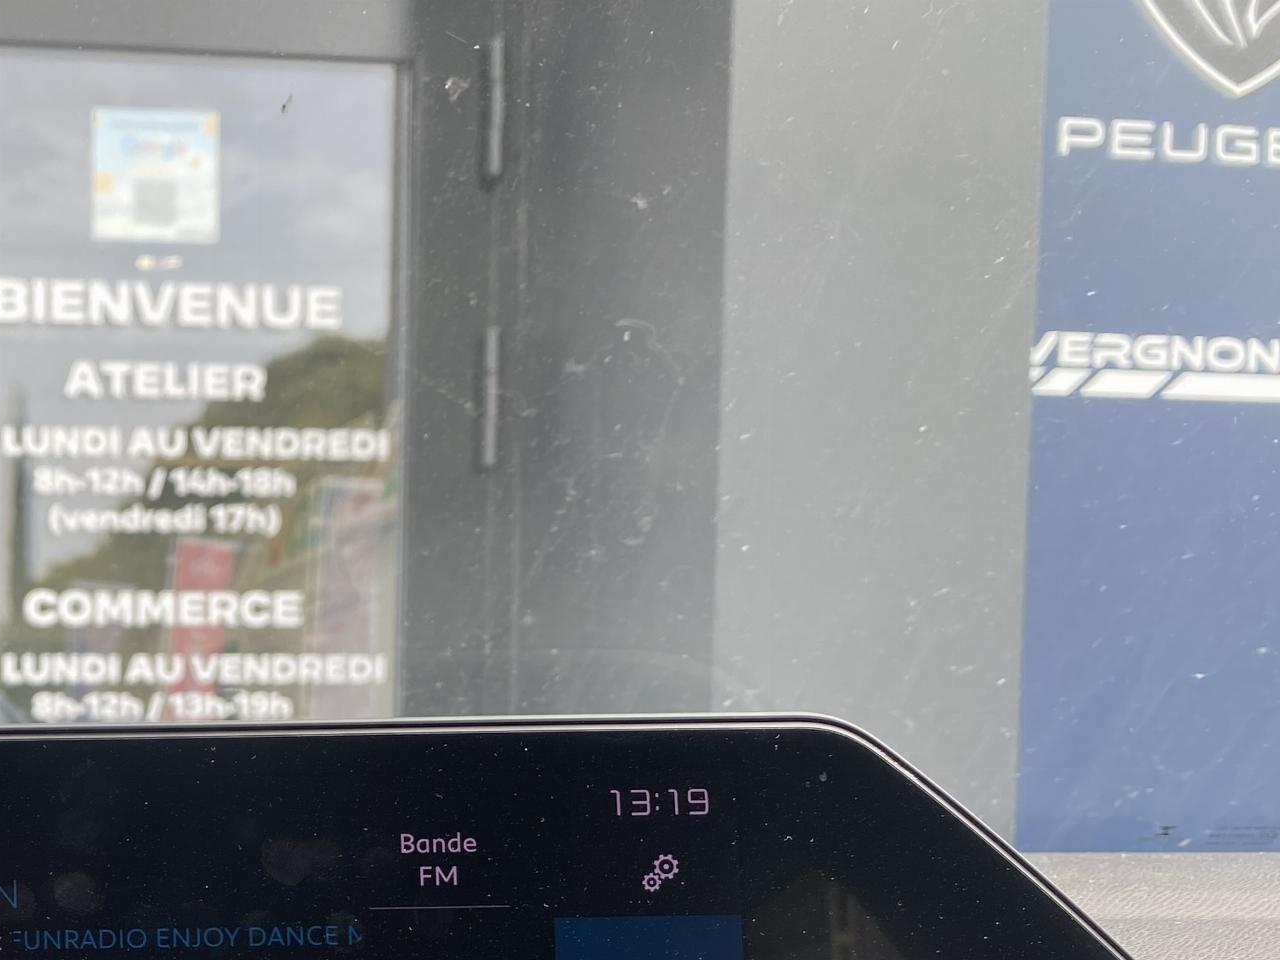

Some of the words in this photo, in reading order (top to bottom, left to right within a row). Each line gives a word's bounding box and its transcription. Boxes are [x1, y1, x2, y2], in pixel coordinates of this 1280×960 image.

[64, 359, 268, 402] ATELIER
[1, 424, 120, 459] LUNDI
[127, 426, 186, 460] AU
[191, 428, 390, 462] VENDREDI
[32, 465, 146, 497] 8h-12h
[169, 466, 297, 498] 14h-18h
[48, 502, 207, 536] (vendredi
[208, 502, 282, 539] 17h)
[23, 588, 305, 629] COMMERCE
[1, 653, 121, 684] LUNDI
[126, 653, 186, 684] AU
[190, 653, 387, 684] VENDREDI
[31, 690, 145, 722] 8h-12h
[169, 690, 294, 721] 13h-19h
[610, 788, 710, 816] 13:19
[400, 832, 478, 854] Bande
[419, 865, 459, 886] FM
[157, 926, 241, 949] ENJOY
[249, 924, 339, 948] DANCE
